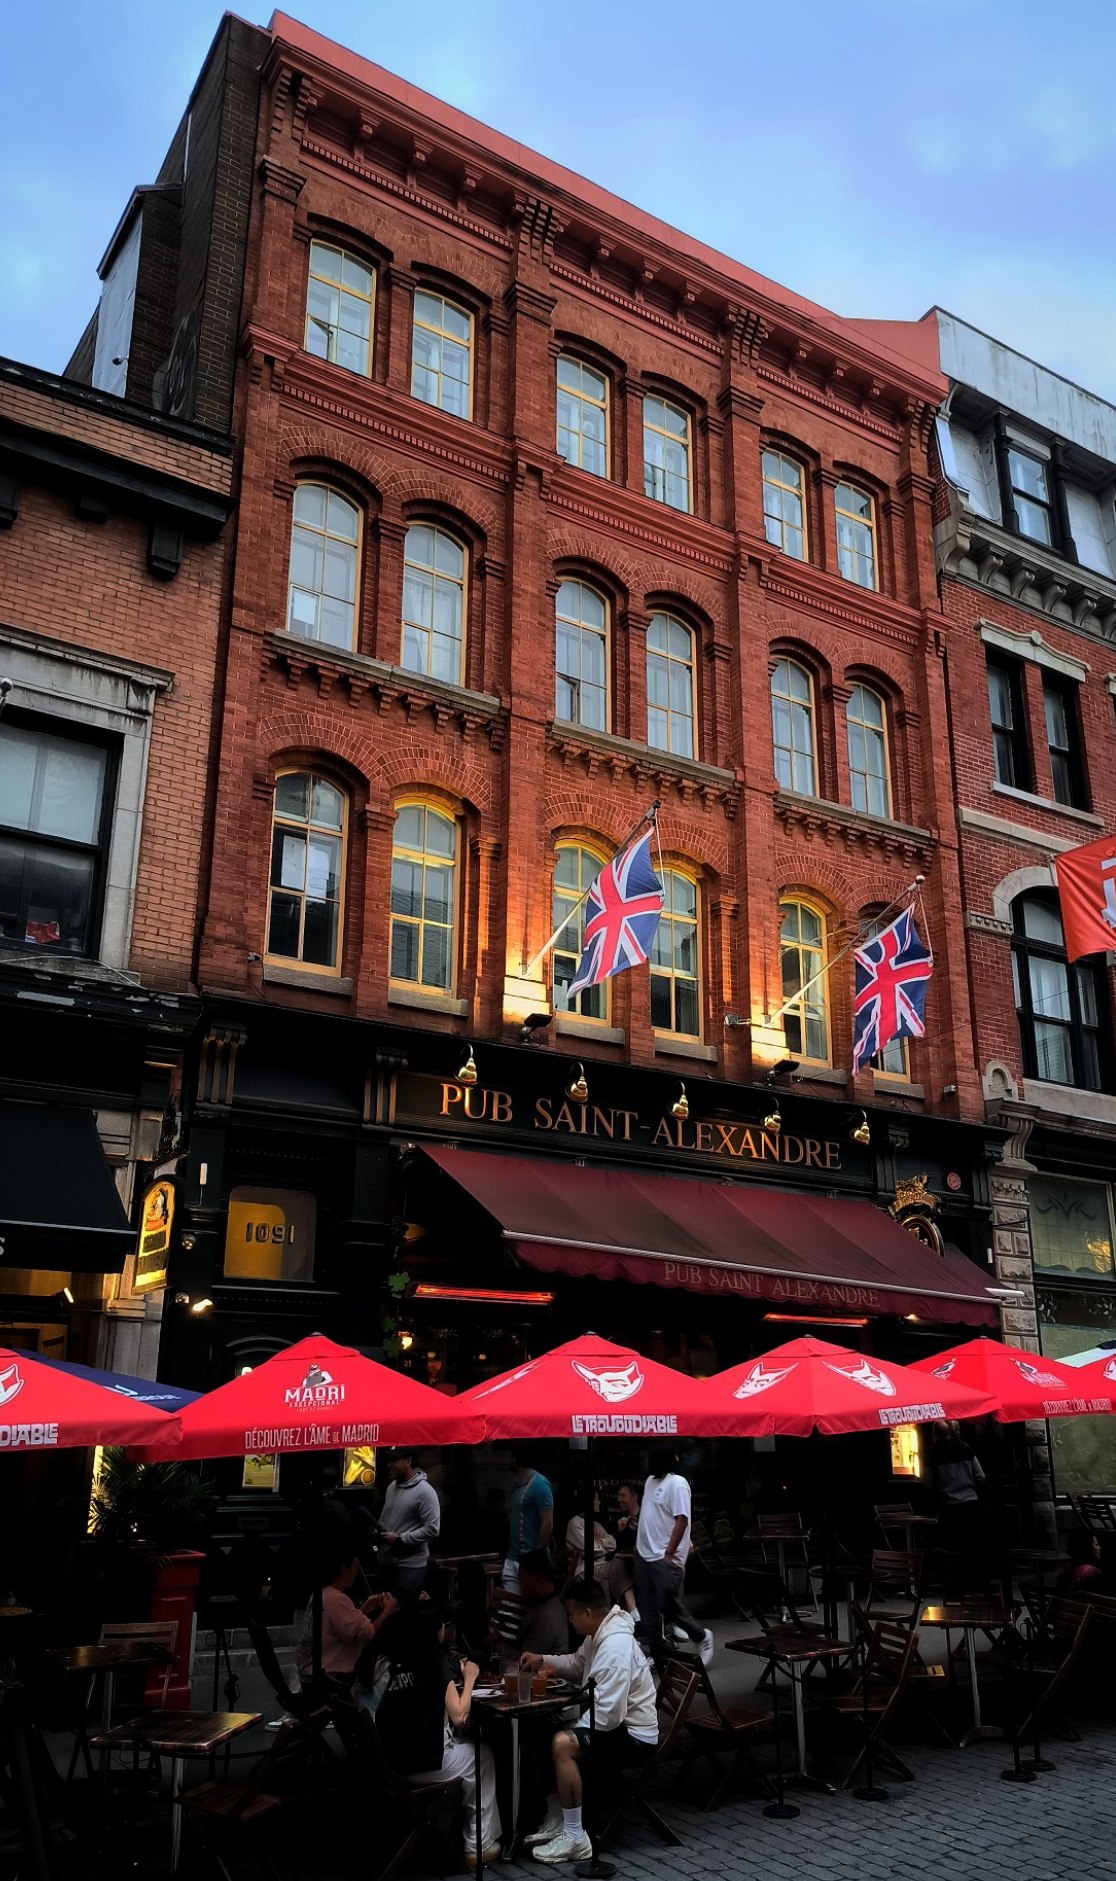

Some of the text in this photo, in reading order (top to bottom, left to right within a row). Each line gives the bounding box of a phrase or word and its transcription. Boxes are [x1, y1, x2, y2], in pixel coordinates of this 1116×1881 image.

[440, 1083, 513, 1122] PUB
[246, 1221, 295, 1244] 1091
[664, 1261, 880, 1307] PUB SAINT ALEXANDRE
[284, 1384, 345, 1403] MADRI
[245, 1426, 302, 1449] DÉCOUVREZ
[341, 1423, 380, 1443] MADRID
